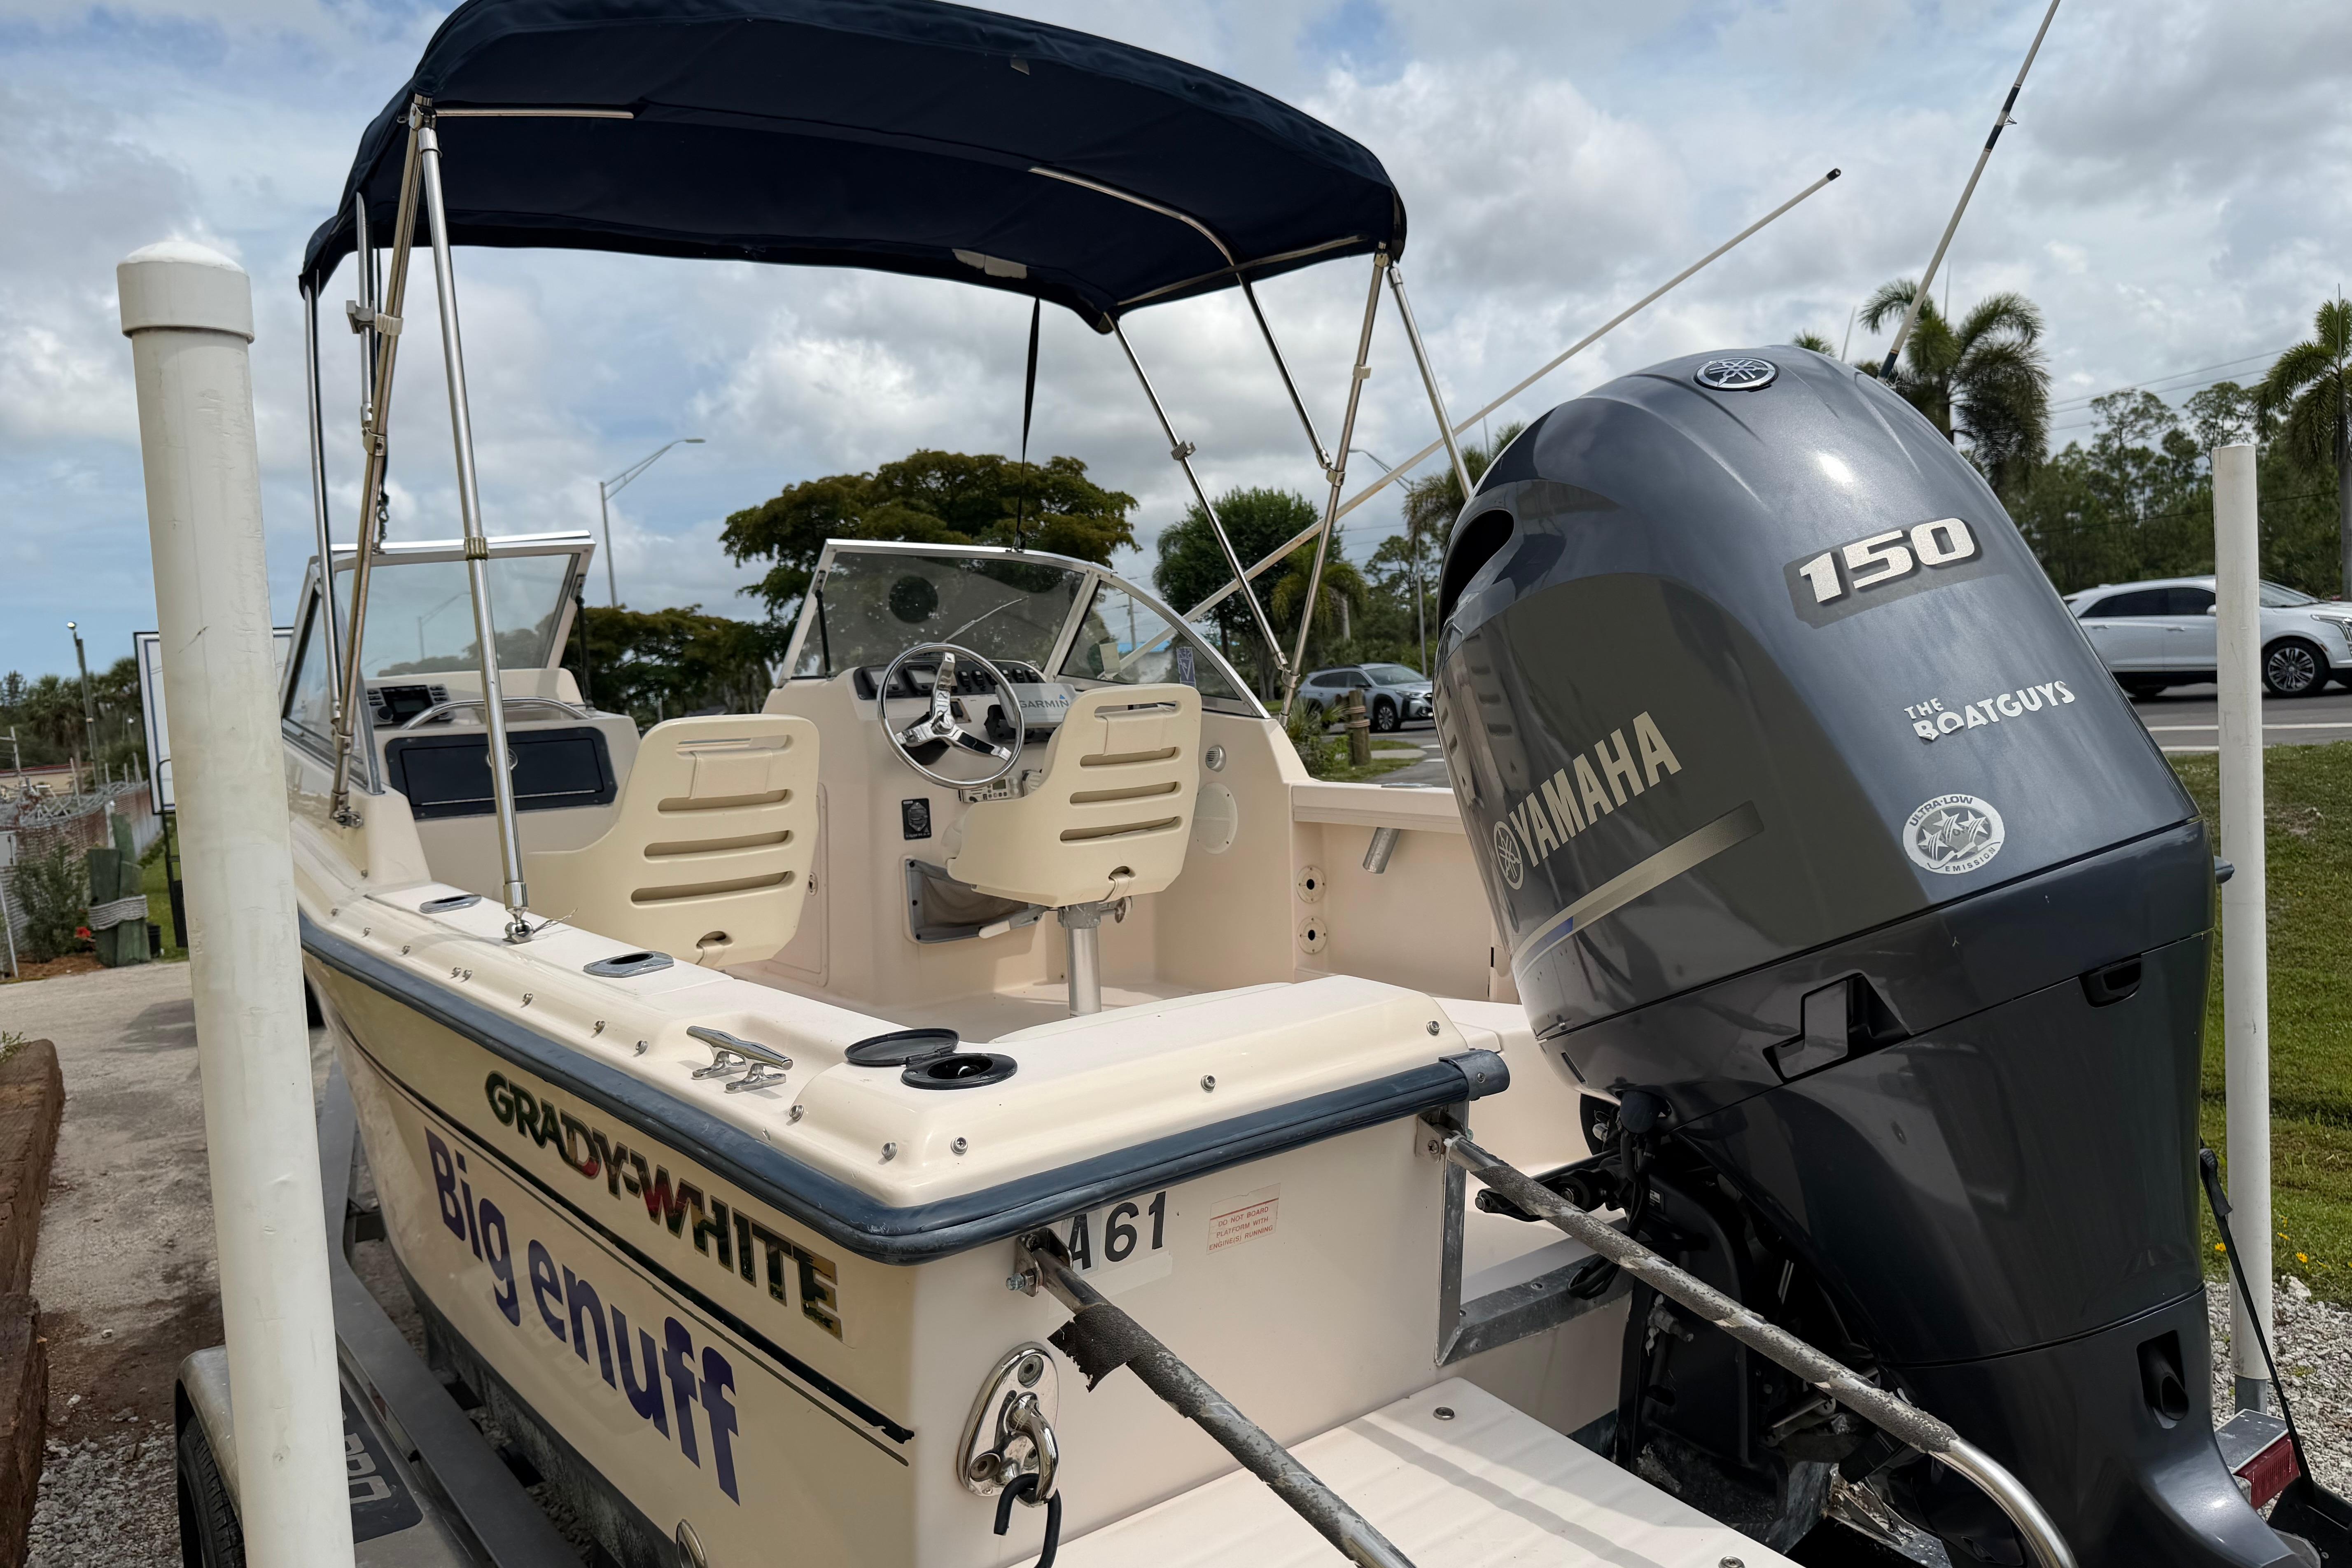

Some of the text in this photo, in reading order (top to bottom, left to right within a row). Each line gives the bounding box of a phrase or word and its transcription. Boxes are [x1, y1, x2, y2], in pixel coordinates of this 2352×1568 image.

[1799, 518, 1975, 603] 150
[1020, 700, 1070, 708] GARMIN
[1904, 698, 1944, 719] THE
[1509, 711, 1682, 868] YAMAHA
[1945, 847, 1996, 872] EMISSION
[485, 1070, 842, 1341] GRADY-WHITE
[1230, 1214, 1244, 1223] NOT
[1246, 1206, 1269, 1218] BOARD
[1209, 1225, 1273, 1251] ENGINE(S) RUNNING
[1216, 1216, 1269, 1238] PLATFORM WITH
[425, 1126, 740, 1506] Big enuff
